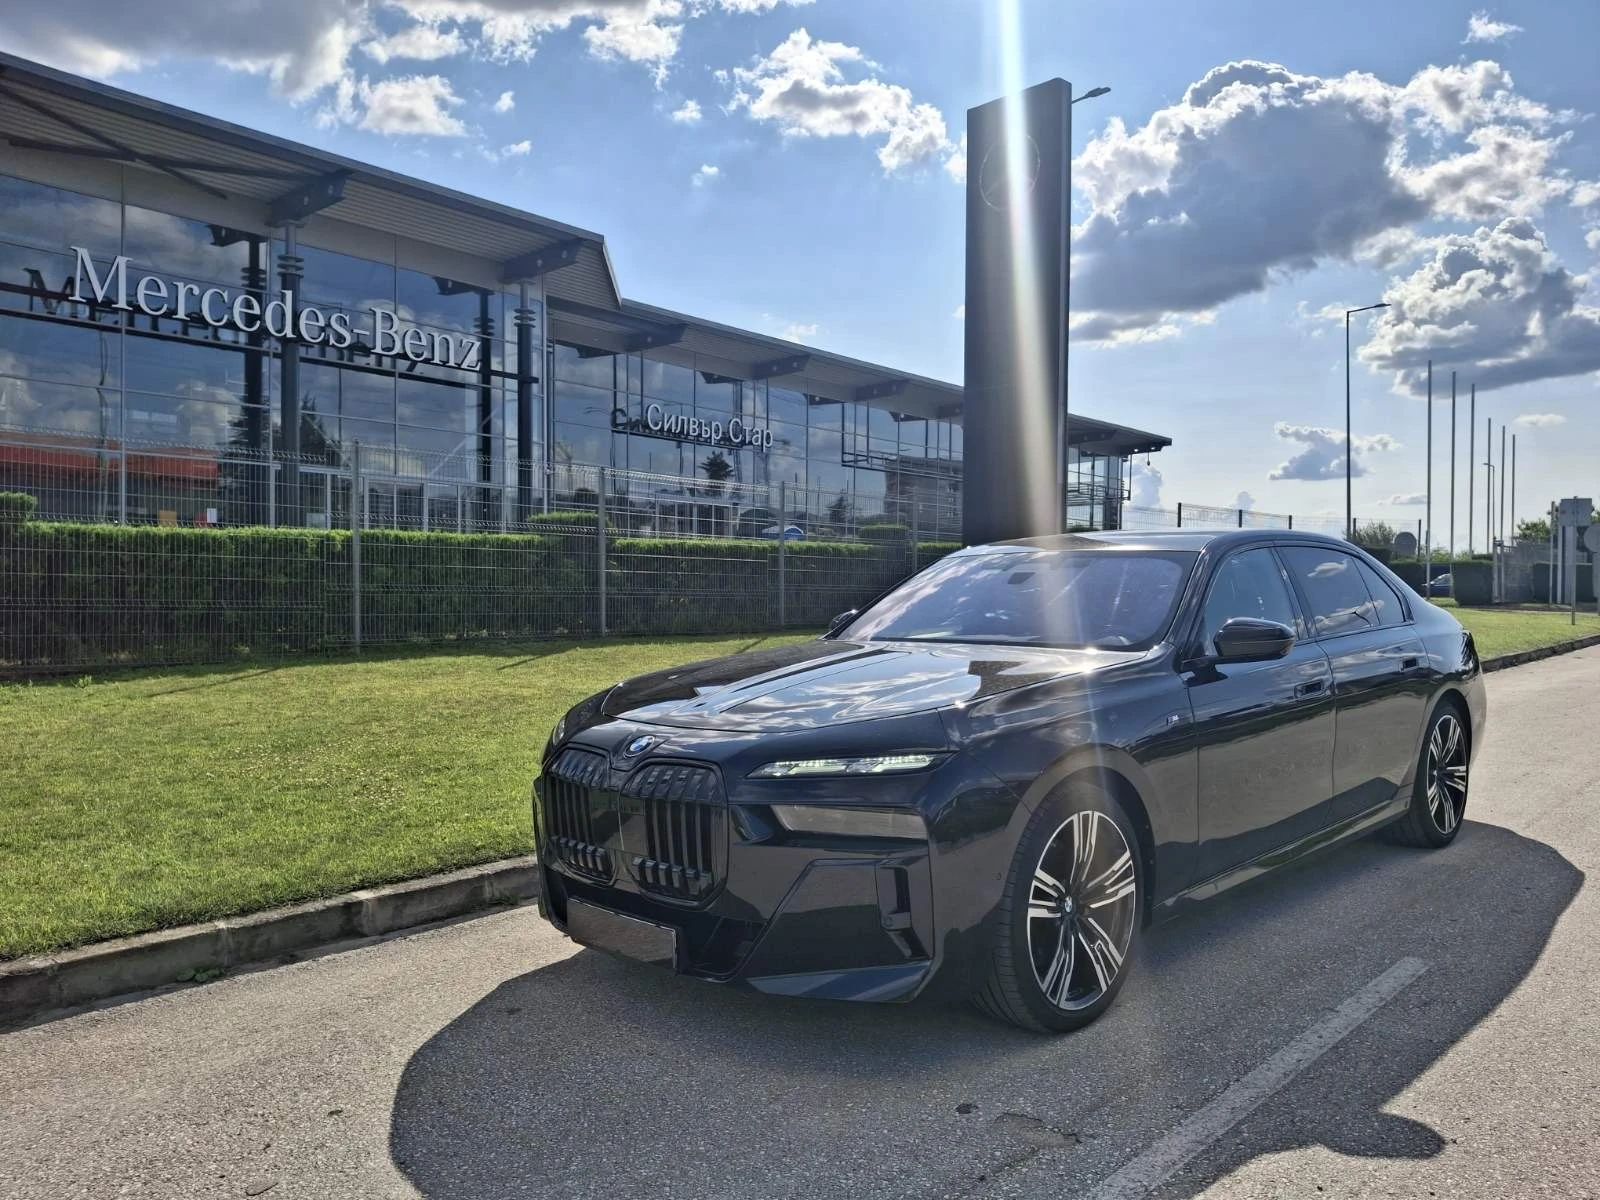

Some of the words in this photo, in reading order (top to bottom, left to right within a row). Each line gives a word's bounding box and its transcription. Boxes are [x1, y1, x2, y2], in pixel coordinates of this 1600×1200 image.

[69, 246, 481, 372] Mercedes-Benz
[647, 403, 722, 445] Силвър
[729, 418, 773, 452] Стар
